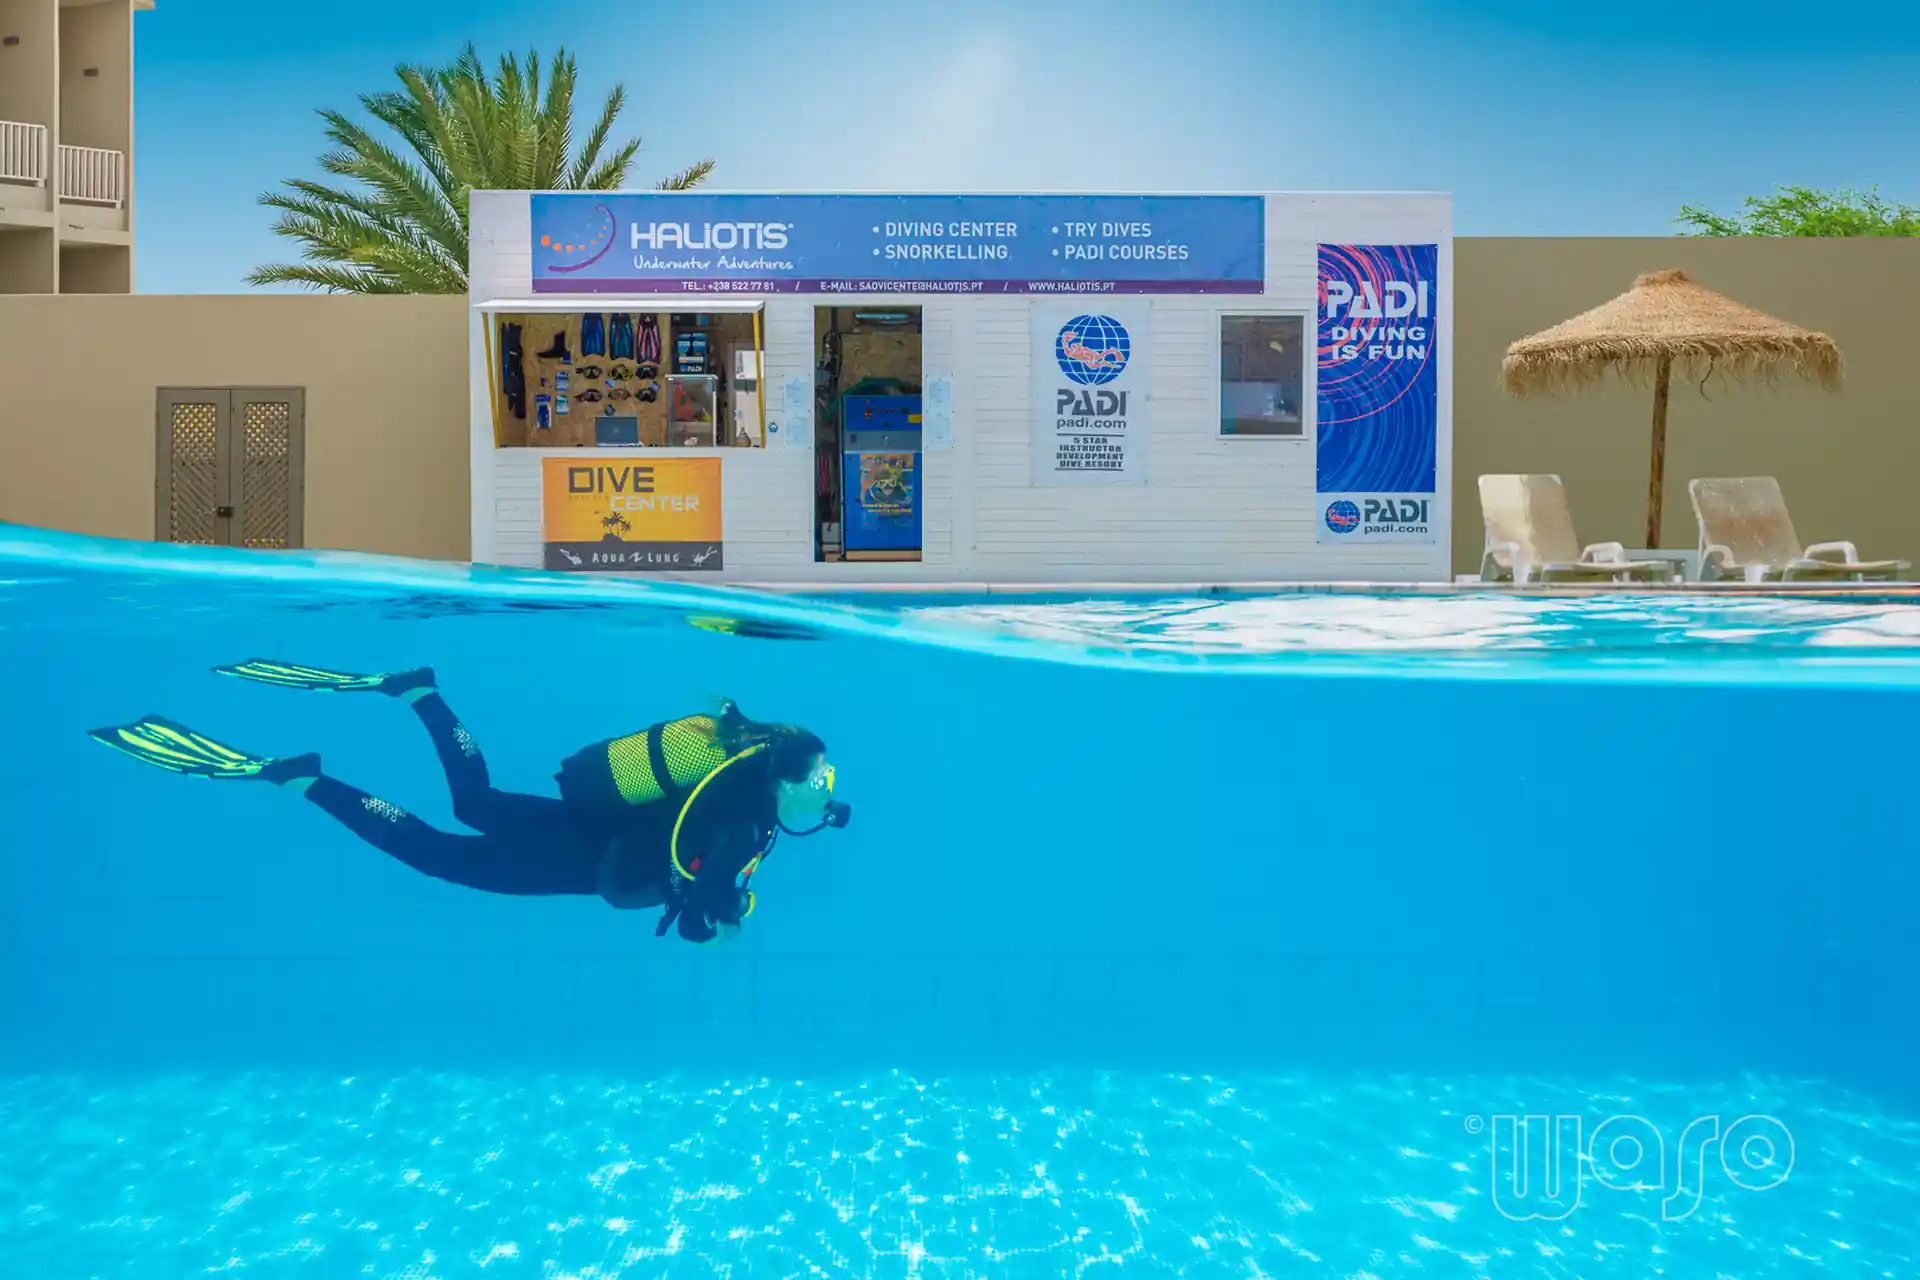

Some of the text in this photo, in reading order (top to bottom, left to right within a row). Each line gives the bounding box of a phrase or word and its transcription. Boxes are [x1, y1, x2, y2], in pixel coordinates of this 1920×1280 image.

[885, 221, 1018, 237] DIVING CENTER
[1064, 222, 1151, 237] TRY DIVES
[885, 244, 1008, 260] SNORKELLING
[1064, 244, 1188, 260] PADI COURSES
[633, 254, 794, 271] Underwater Adventures
[1327, 281, 1428, 318] PADI
[1331, 327, 1426, 341] DIVING
[1332, 345, 1426, 360] IS FUN
[1056, 389, 1127, 416] PADI
[1056, 417, 1127, 430] padi.com
[1056, 452, 1124, 460] DEVELOPMENT
[568, 466, 655, 493] DIVE
[610, 496, 700, 512] CENTER
[1364, 499, 1428, 523] PADI
[1364, 523, 1428, 534] padi.com
